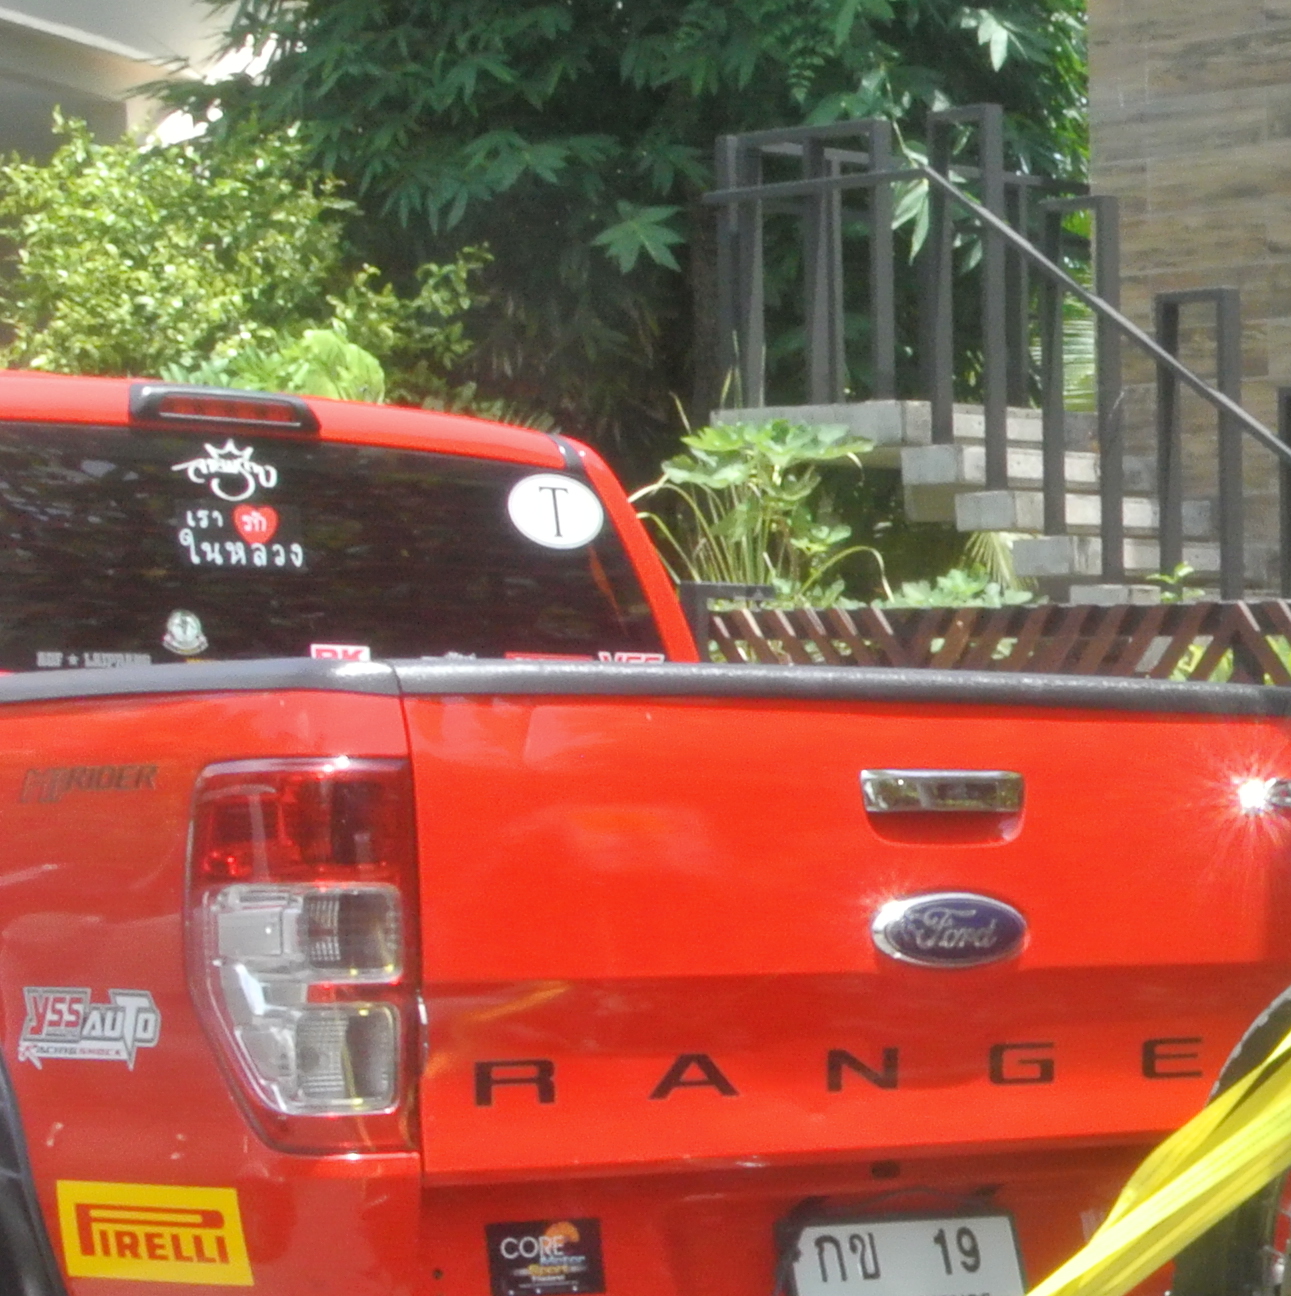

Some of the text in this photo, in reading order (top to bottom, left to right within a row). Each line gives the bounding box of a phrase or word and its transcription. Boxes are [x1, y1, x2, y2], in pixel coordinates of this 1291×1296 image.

[186, 510, 268, 532] เรา รัก
[538, 486, 569, 537] T
[179, 528, 304, 568] ในหลวง
[916, 906, 998, 950] Ford
[29, 995, 157, 1052] YSS AUTO
[474, 1036, 1204, 1107] RANGE
[75, 1202, 230, 1265] PIRELLI
[500, 1235, 564, 1259] CORE
[814, 1226, 982, 1283] กข 19
